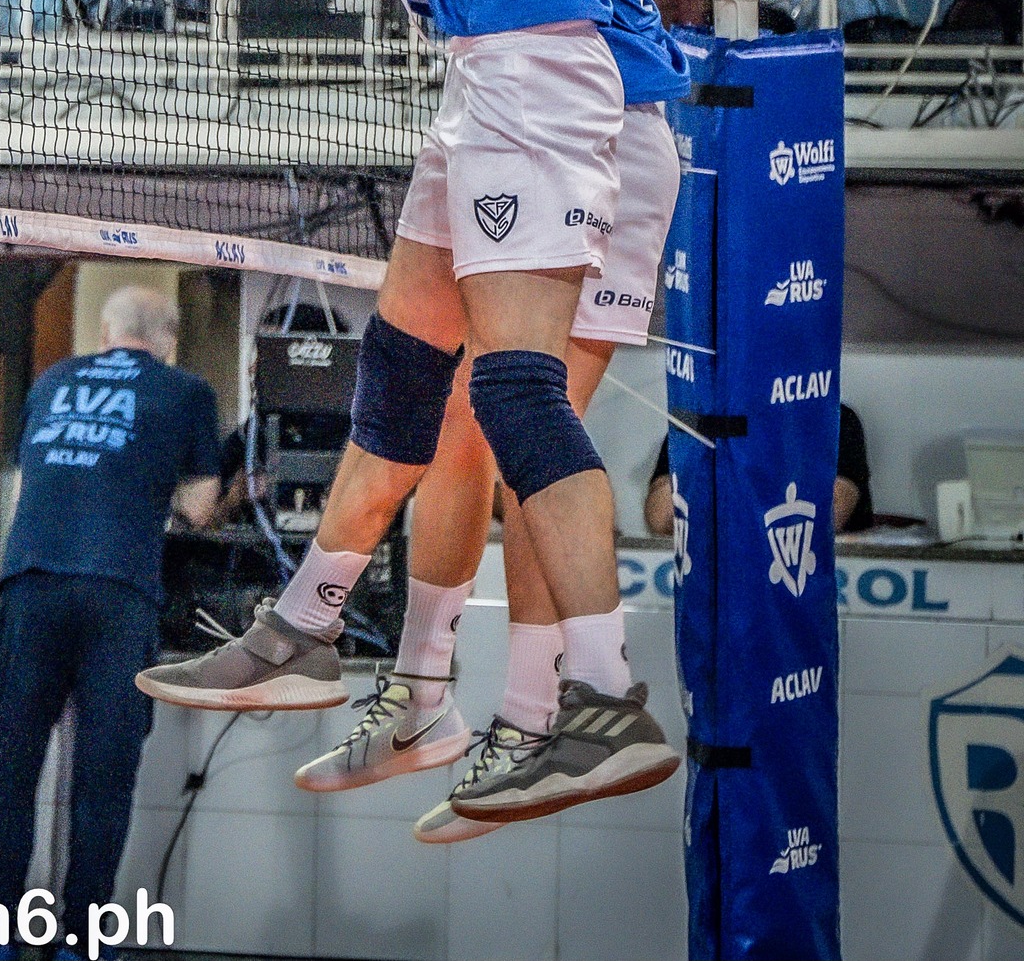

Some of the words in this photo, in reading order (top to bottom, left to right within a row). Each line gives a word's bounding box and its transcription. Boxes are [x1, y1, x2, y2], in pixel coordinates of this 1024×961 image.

[793, 139, 835, 166] Wolfi
[790, 260, 814, 282] LVA
[790, 278, 824, 303] RUS
[770, 370, 832, 404] ACLAV
[50, 385, 136, 423] LVA
[771, 666, 823, 704] ACLAV
[787, 826, 809, 848] LVA
[790, 844, 818, 870] RUS
